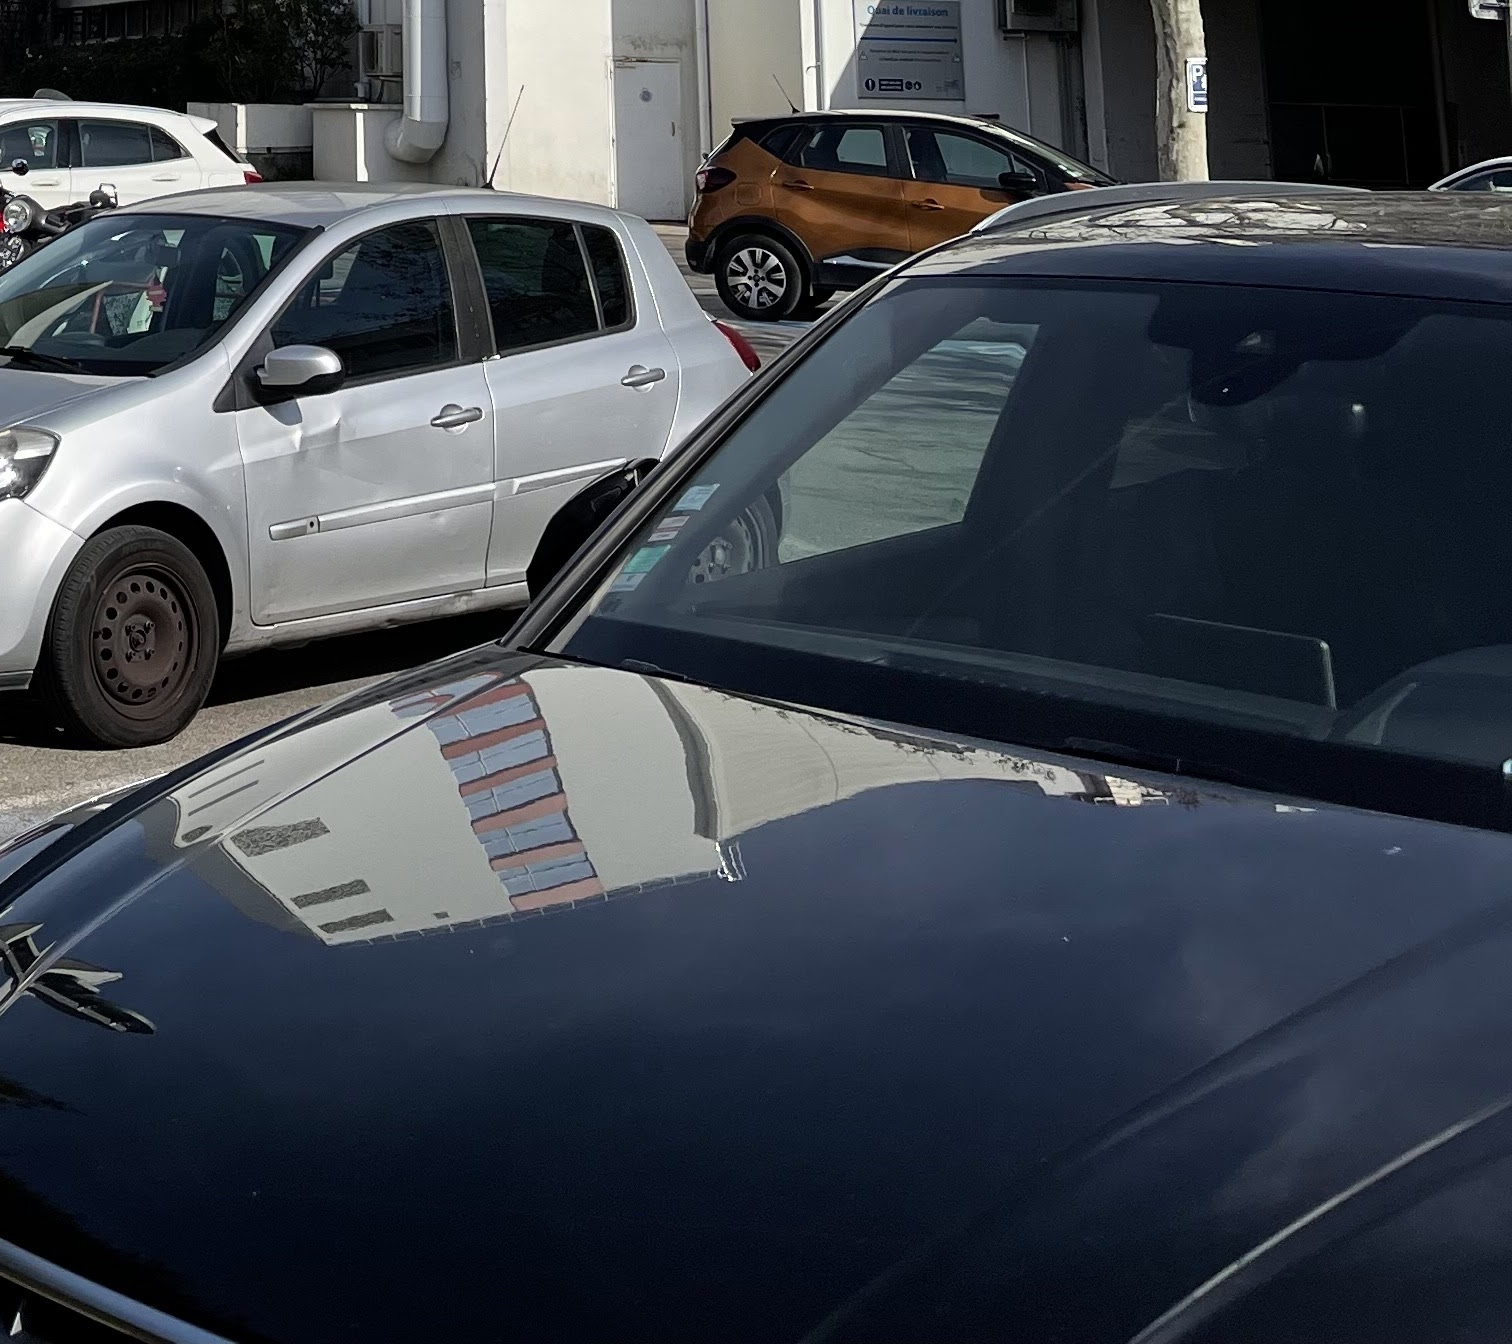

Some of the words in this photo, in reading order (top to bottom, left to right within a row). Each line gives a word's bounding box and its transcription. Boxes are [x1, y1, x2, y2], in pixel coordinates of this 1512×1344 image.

[867, 5, 890, 15] Quai
[892, 6, 904, 16] de
[907, 6, 948, 17] livraison
[1192, 64, 1204, 83] P
